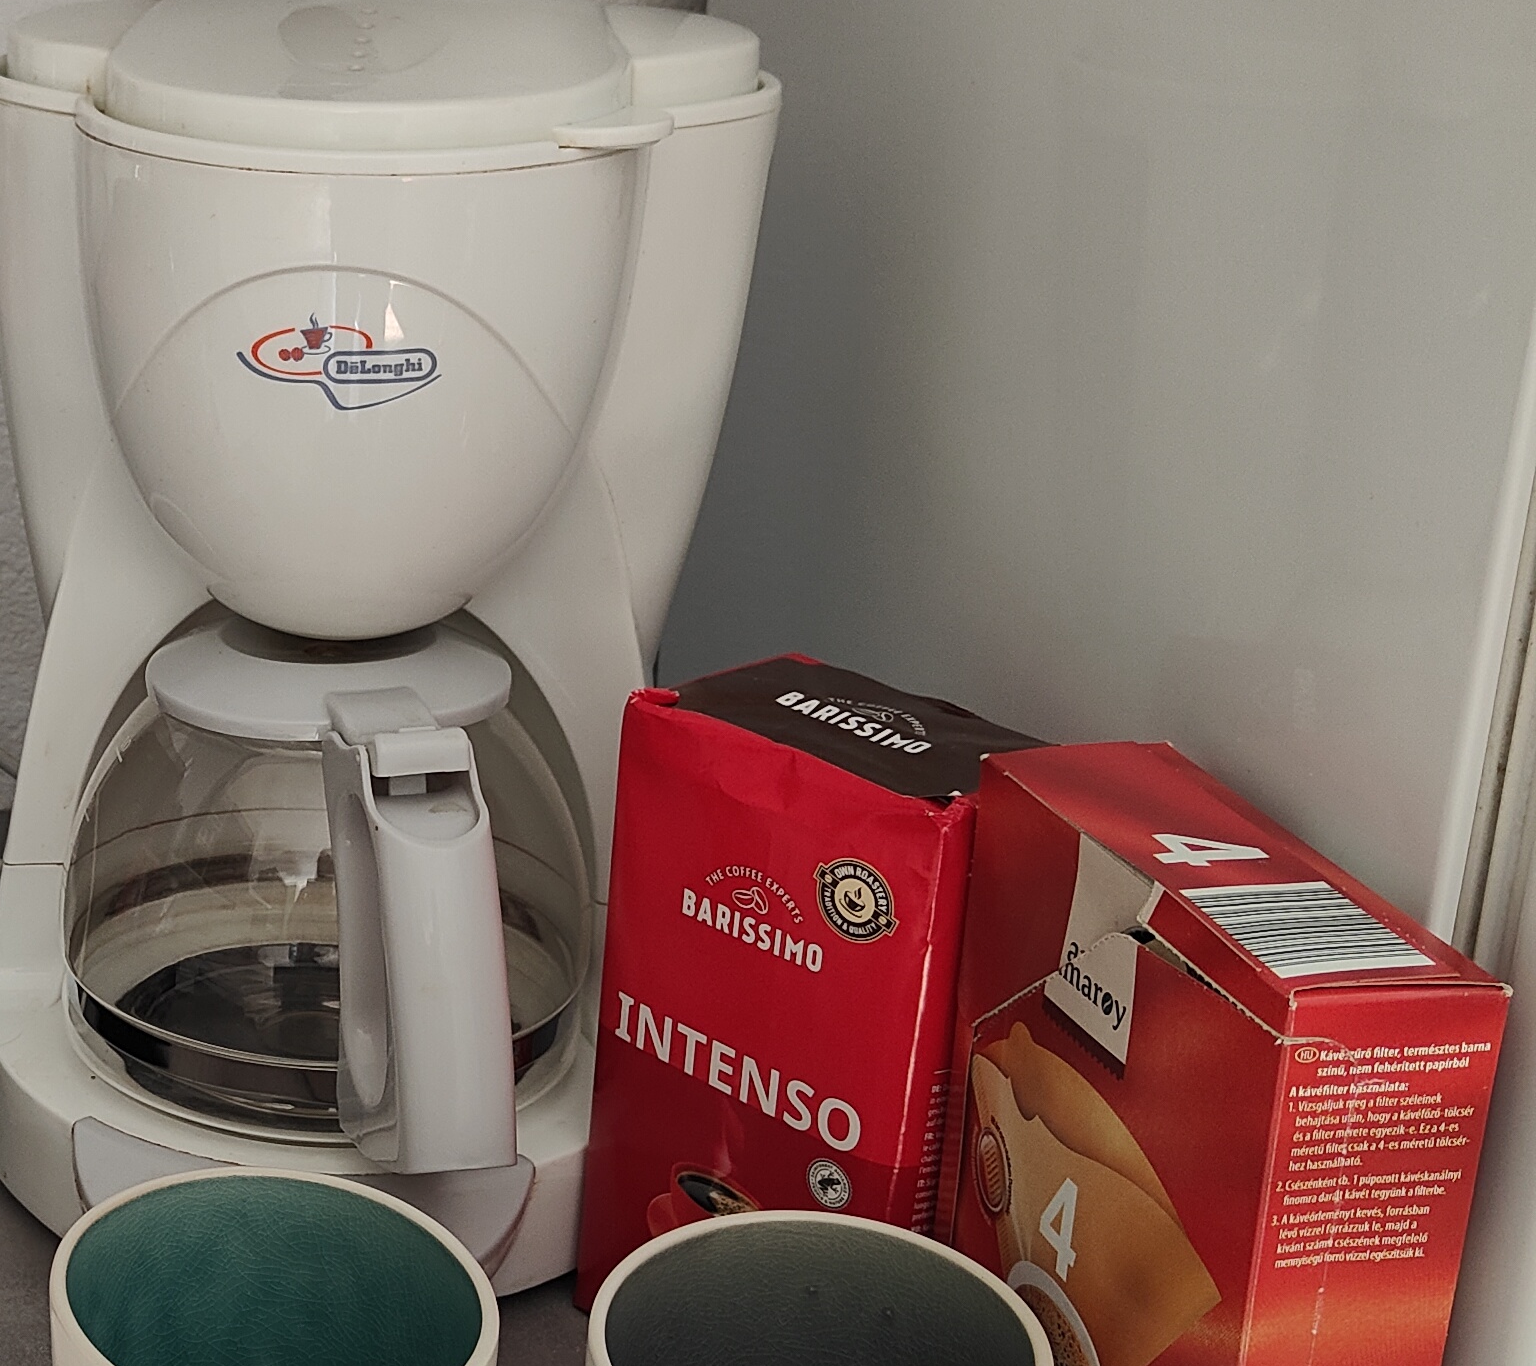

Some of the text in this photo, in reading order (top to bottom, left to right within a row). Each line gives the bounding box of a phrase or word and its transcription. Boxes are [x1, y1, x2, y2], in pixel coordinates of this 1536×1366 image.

[775, 691, 932, 753] BARISSIMO
[1151, 833, 1270, 866] 4
[705, 866, 803, 924] THE COFFEE EXPERTS
[824, 887, 843, 926] TRADITION
[848, 922, 877, 935] QUALITY
[834, 865, 887, 913] OWN ROASTERY
[681, 887, 823, 973] BARISSIMO
[614, 991, 862, 1153] INTENSO
[1300, 1049, 1314, 1060] HU
[1373, 1046, 1401, 1059] filter,
[1461, 1041, 1491, 1053] barna
[1349, 1064, 1372, 1075] nem
[1289, 1086, 1297, 1097] A
[1298, 1084, 1349, 1097] kávéfilter
[1295, 1114, 1340, 1128] behajtása
[1367, 1111, 1391, 1124] hogy
[1347, 1140, 1369, 1152] csak
[1039, 1177, 1078, 1282] 4
